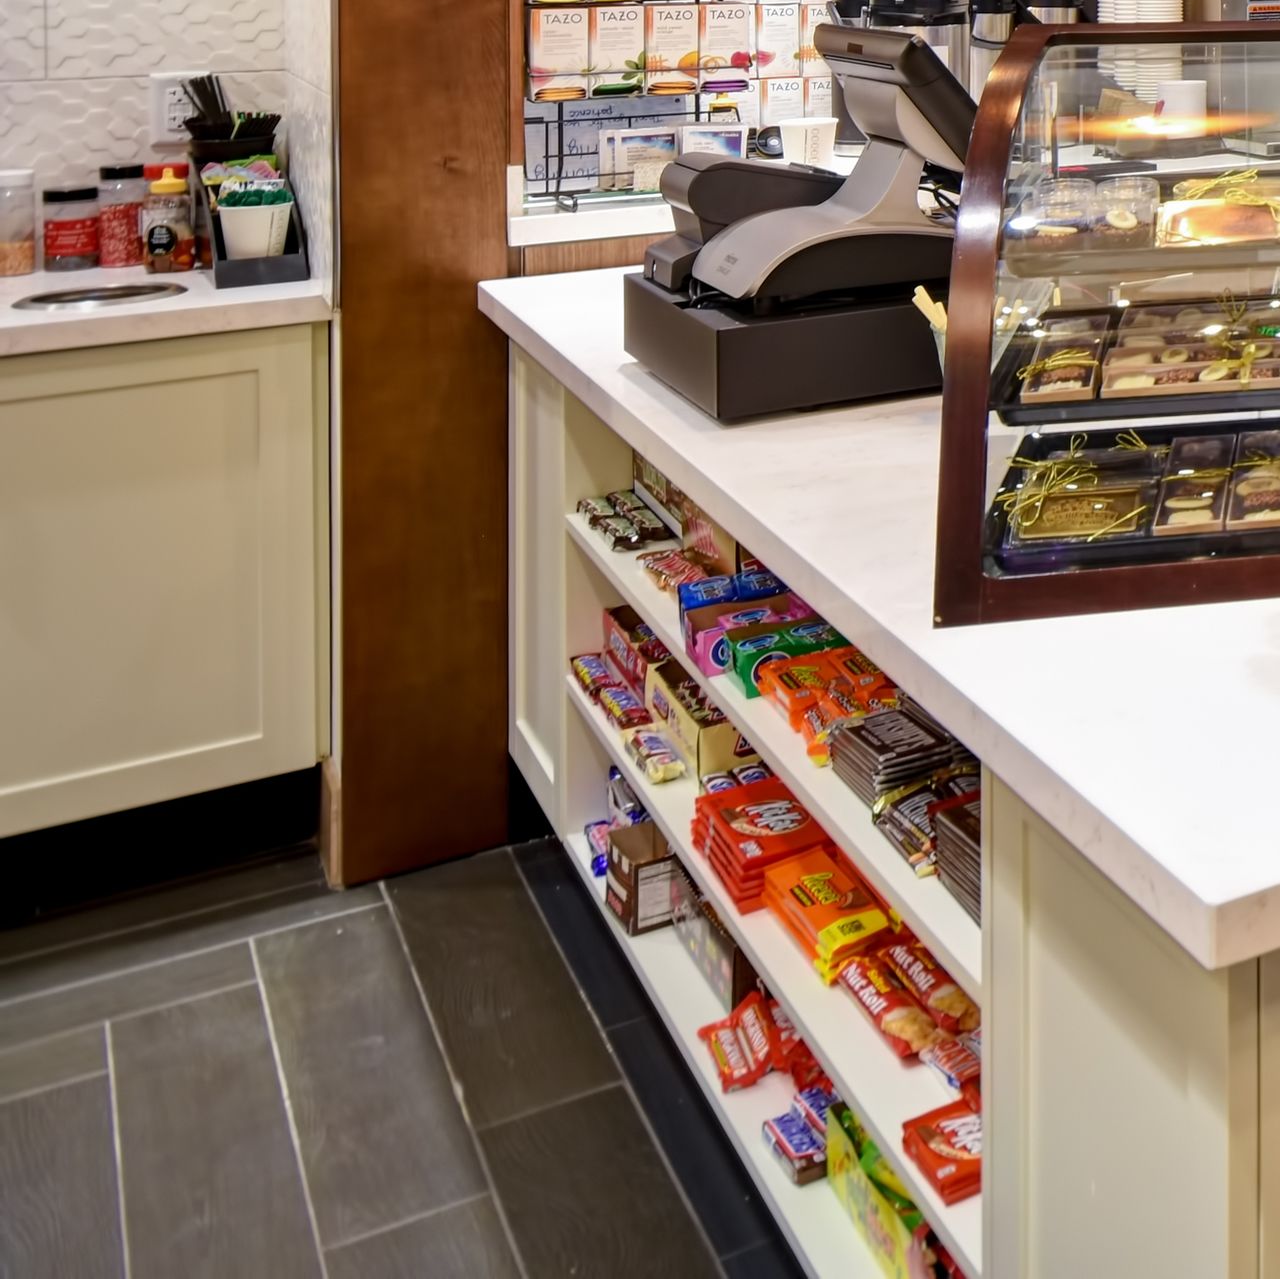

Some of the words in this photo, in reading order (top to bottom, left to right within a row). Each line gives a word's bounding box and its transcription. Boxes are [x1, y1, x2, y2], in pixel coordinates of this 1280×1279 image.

[600, 10, 638, 21] TAZO
[657, 10, 693, 21] TAZO
[710, 9, 745, 20] TAZO
[766, 8, 794, 17] TAZO
[543, 13, 582, 24] TAZO
[771, 82, 800, 91] TAZO
[812, 81, 832, 90] TAZ
[888, 945, 915, 970] Nut
[907, 961, 936, 992] Roll
[842, 962, 869, 991] Nut
[857, 984, 889, 1016] Roll
